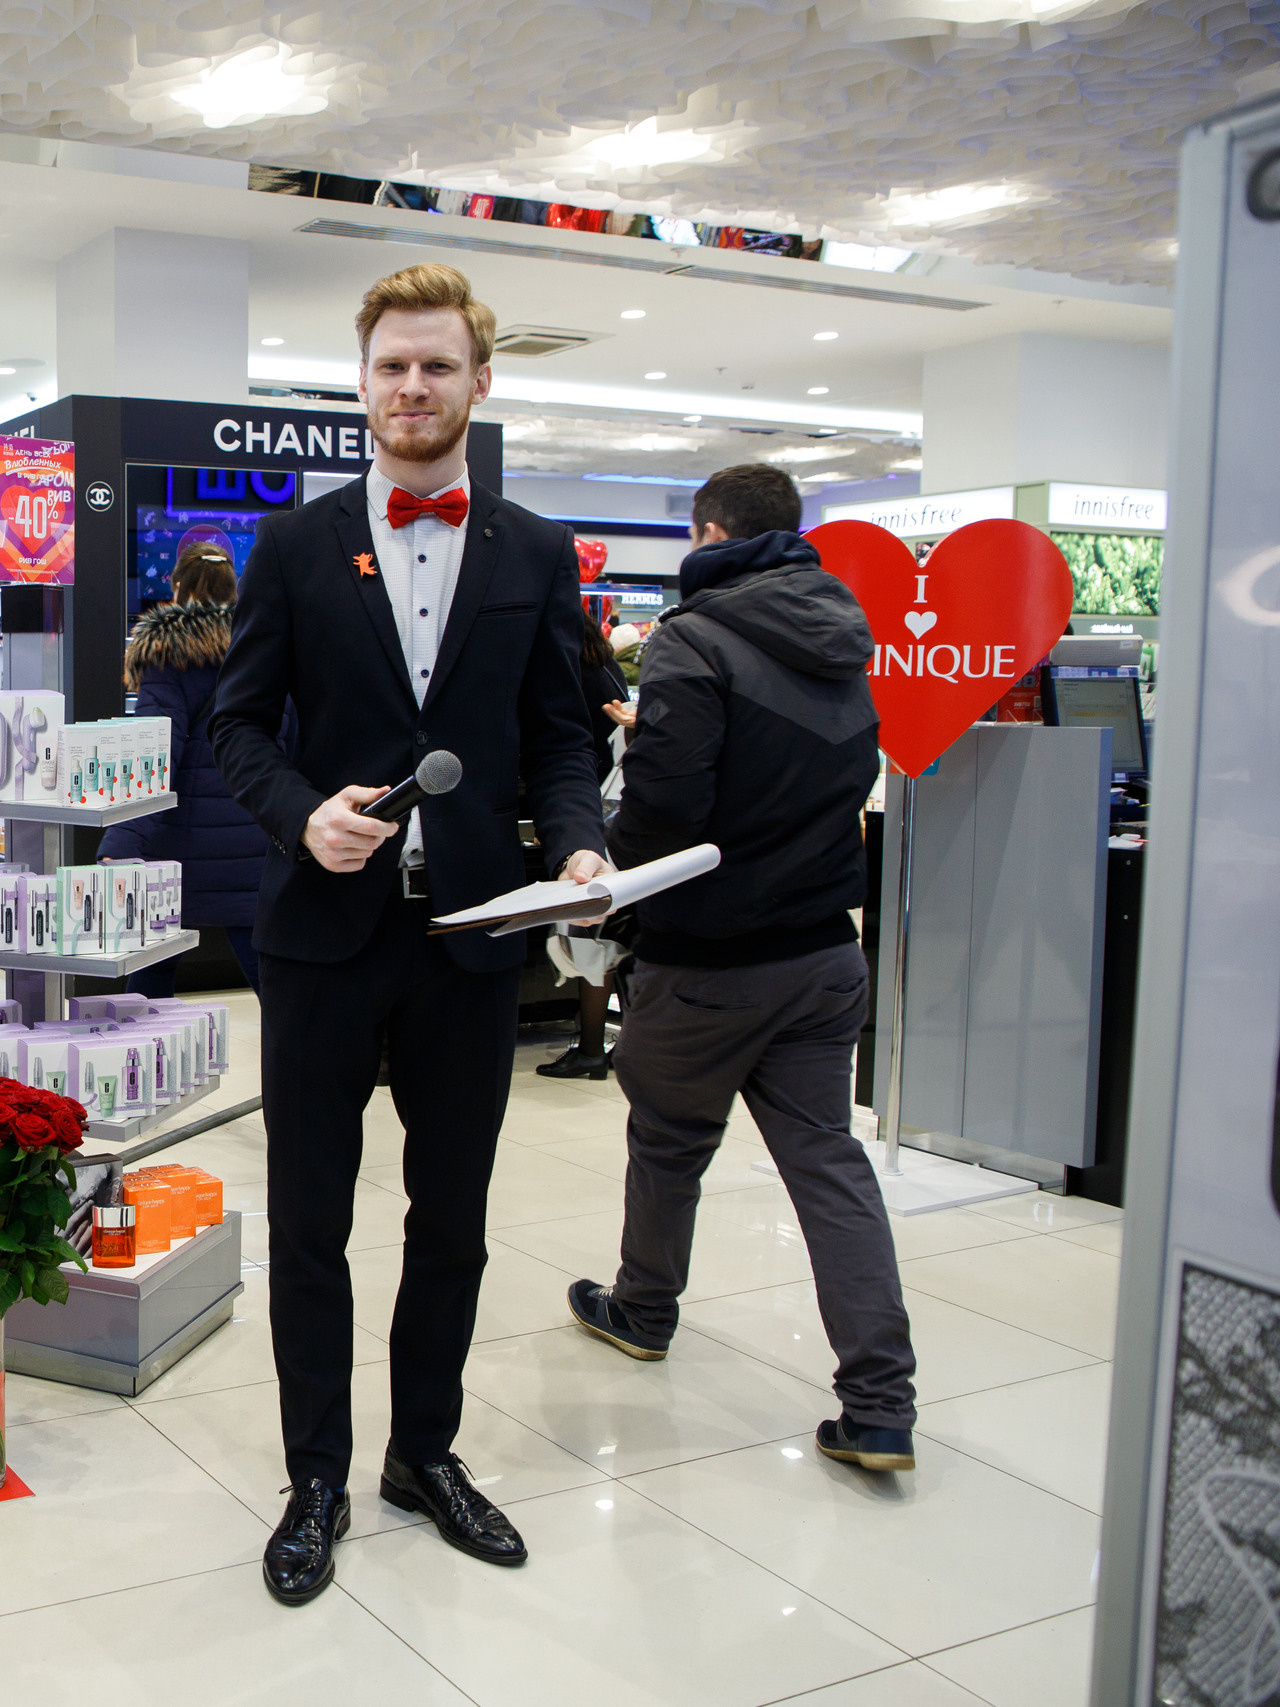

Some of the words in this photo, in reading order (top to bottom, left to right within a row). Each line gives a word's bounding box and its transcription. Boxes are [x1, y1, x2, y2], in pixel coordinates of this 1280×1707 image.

[1074, 494, 1155, 520] innisfree
[913, 574, 929, 604] I
[866, 644, 1016, 684] INIQUE
